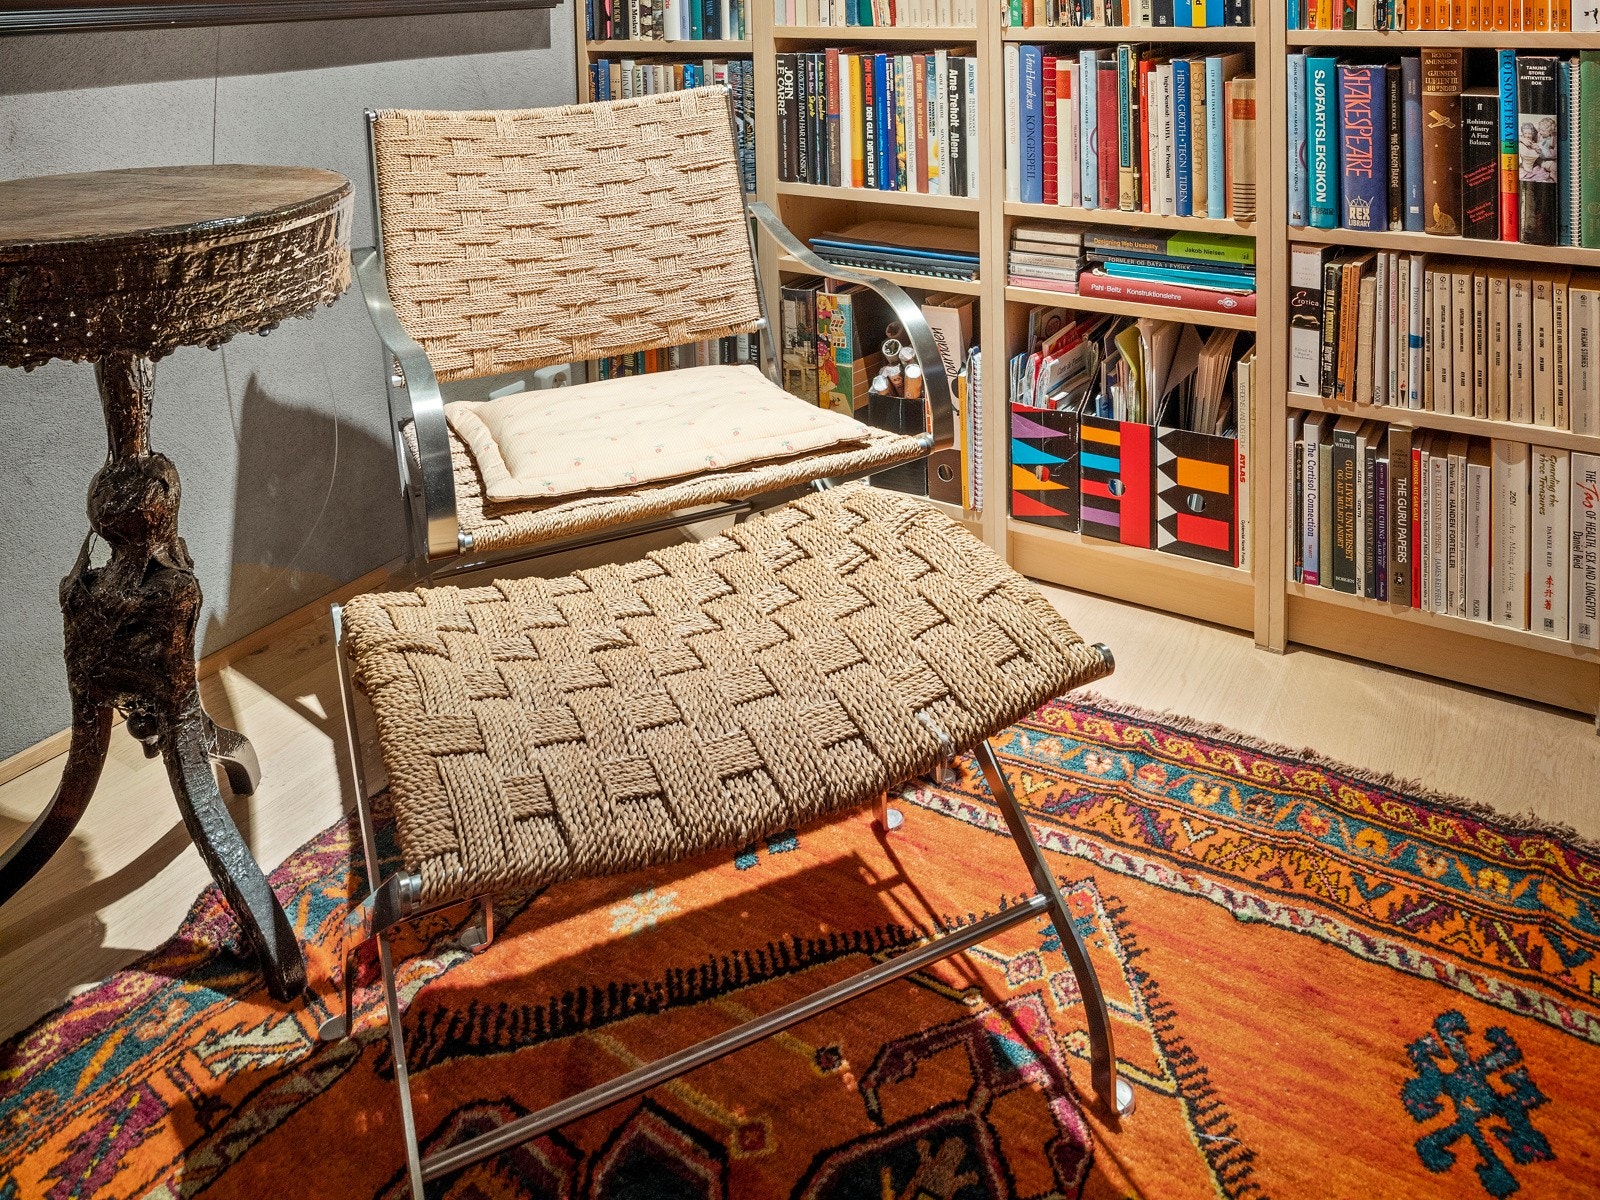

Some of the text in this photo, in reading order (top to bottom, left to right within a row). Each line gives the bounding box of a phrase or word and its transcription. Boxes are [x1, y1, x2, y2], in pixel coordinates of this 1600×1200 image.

[777, 60, 787, 116] LE CARRÉ
[785, 67, 793, 99] JOHN
[1178, 70, 1186, 136] HENRIK GROTH
[1502, 55, 1514, 149] FOTSONETERAPI
[949, 69, 959, 158] Arne Treholt Alene
[1314, 70, 1326, 203] SJØFARTSLEKSIKON
[1343, 69, 1372, 179] SHAKESPEARE
[1026, 115, 1036, 182] KONGESPEIL
[1178, 141, 1186, 168] TEGN
[868, 178, 874, 186] BY
[1179, 175, 1187, 202] TIDEN
[1348, 219, 1370, 227] LIBRARY
[1350, 207, 1370, 220] REX
[1185, 247, 1225, 256] Jakob Nielsen
[1127, 288, 1182, 300] Konstruktionslehre
[1307, 443, 1316, 537] The Cortisol Connection
[1449, 499, 1457, 528] HÅNDEN
[1397, 478, 1407, 563] THE GURU PAPERS
[1573, 531, 1583, 569] Daniel Reid
[1576, 470, 1599, 619] THE Tao OF HEALTH, SEX AND LONGEVITY
